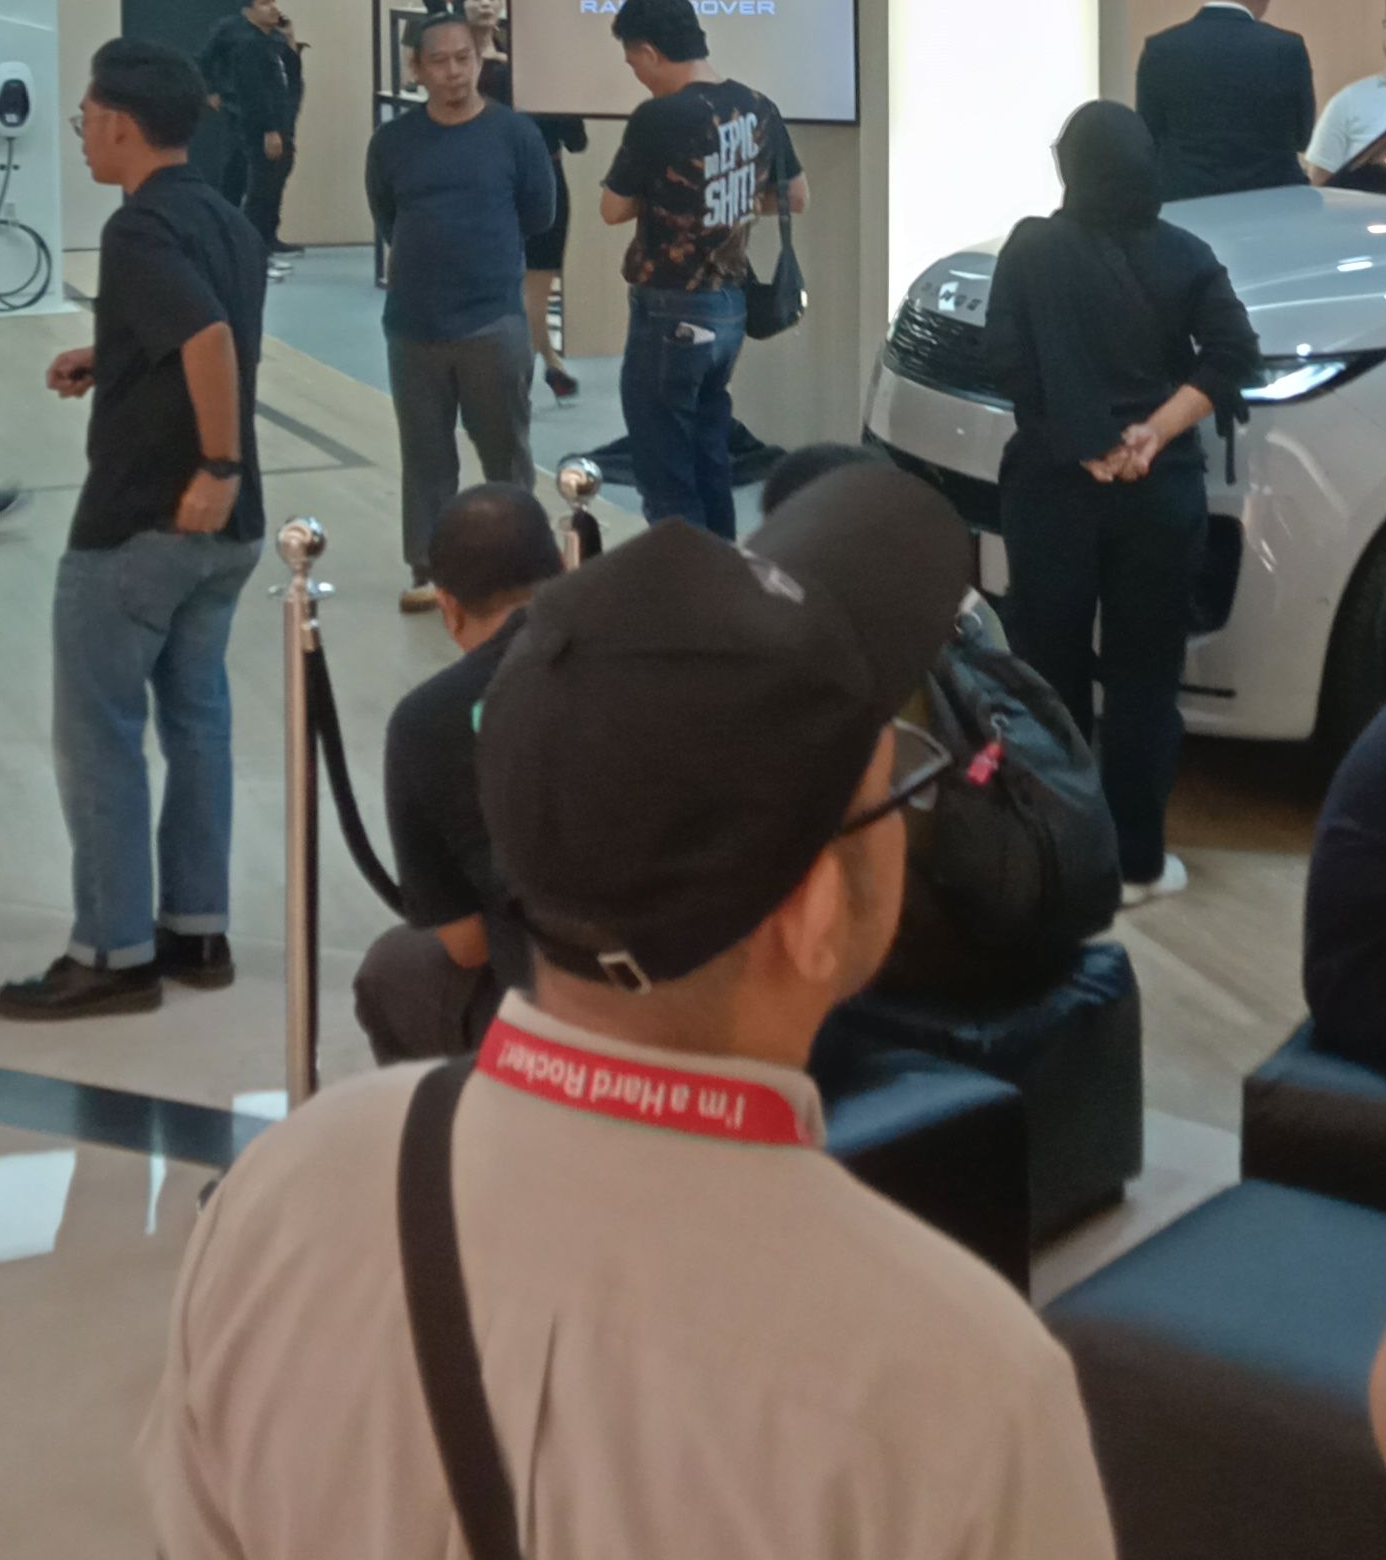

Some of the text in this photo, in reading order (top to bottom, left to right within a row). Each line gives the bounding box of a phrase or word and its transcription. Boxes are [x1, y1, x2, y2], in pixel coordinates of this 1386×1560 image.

[718, 112, 760, 171] EPIC
[702, 162, 756, 227] SHIT!
[589, 1070, 666, 1117] Hard
[670, 1085, 692, 1111] a
[699, 1089, 745, 1130] I'm
